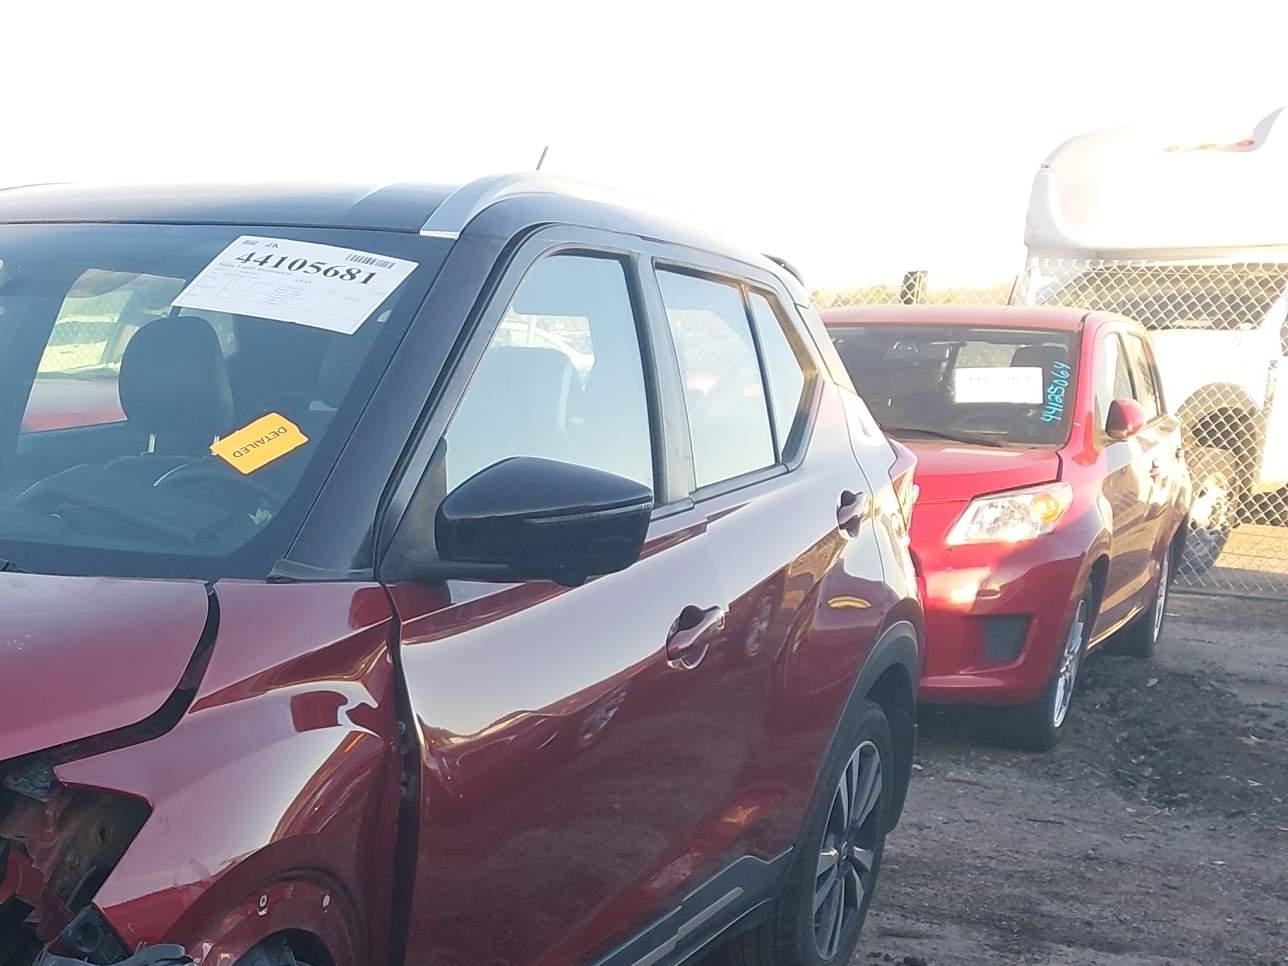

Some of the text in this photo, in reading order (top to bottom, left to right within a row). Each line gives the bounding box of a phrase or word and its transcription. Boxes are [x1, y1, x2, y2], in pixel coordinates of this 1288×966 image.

[236, 252, 377, 285] 44105681
[1041, 362, 1071, 422] 44125064
[233, 426, 287, 458] DETAILED
